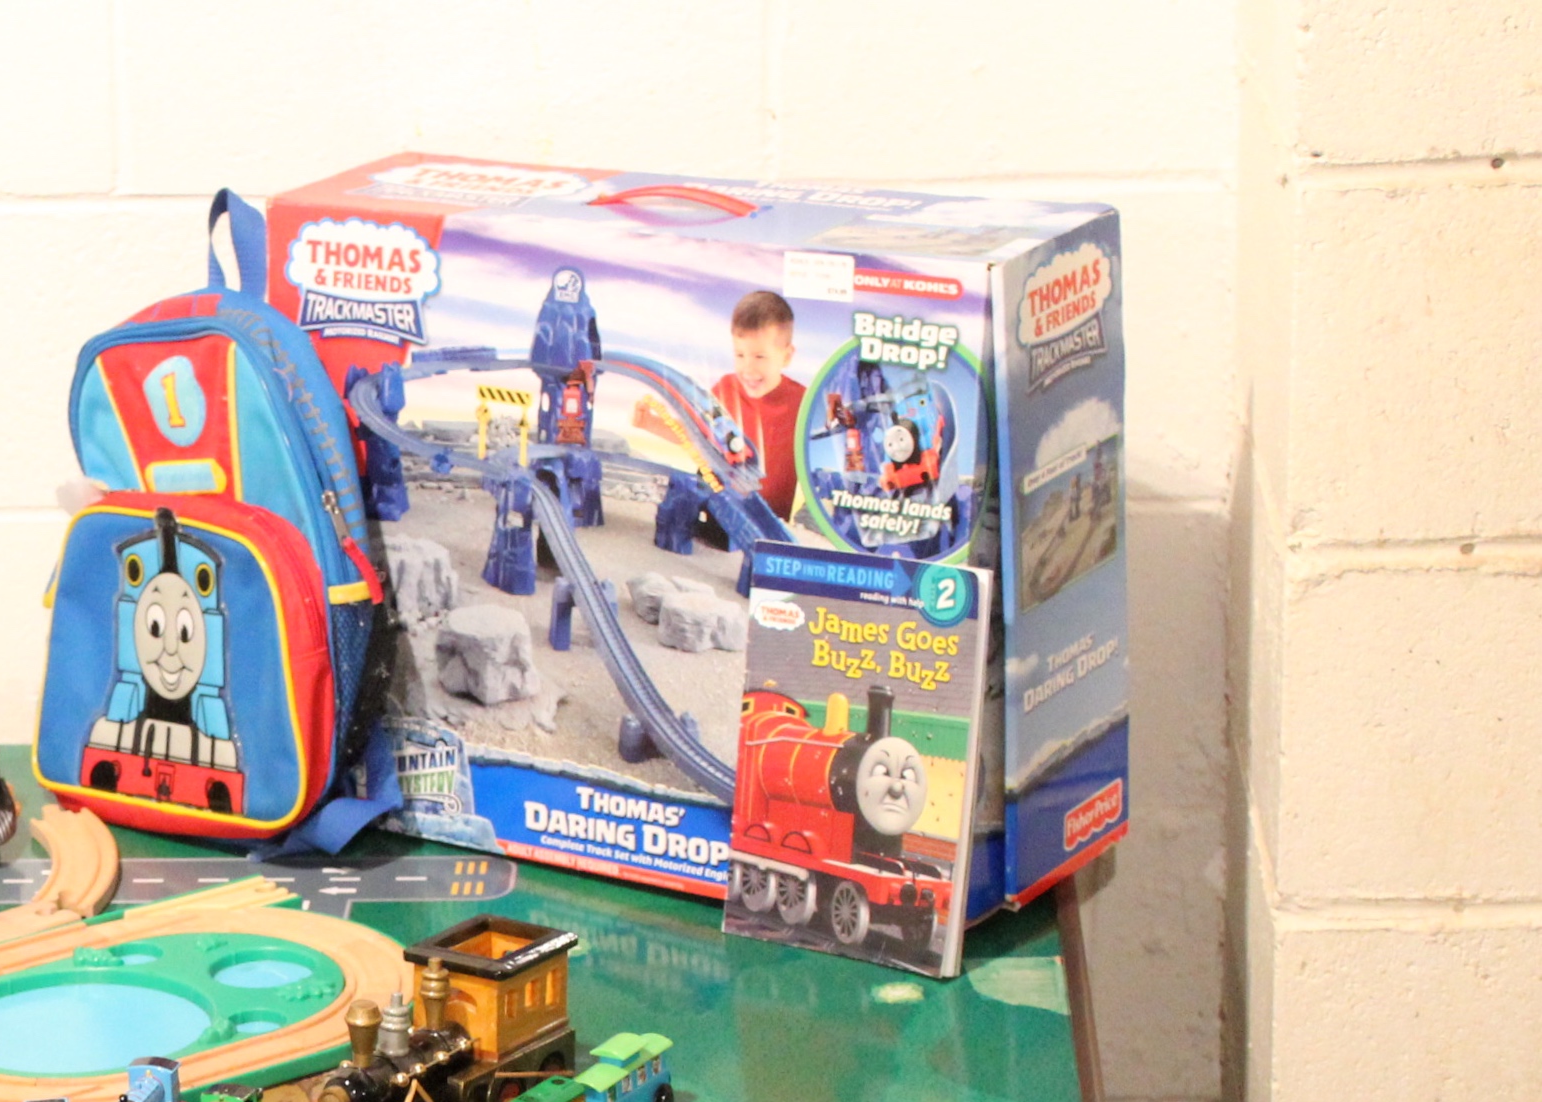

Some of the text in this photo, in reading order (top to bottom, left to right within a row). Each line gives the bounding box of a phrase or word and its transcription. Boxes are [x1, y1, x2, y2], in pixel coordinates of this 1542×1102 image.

[306, 239, 422, 274] THOMAS
[314, 268, 412, 295] & FRIENDS
[855, 275, 890, 288] ONLY
[1028, 258, 1101, 317] THOMAS
[306, 292, 418, 335] TRACKMASTER
[1034, 291, 1097, 338] & FRIENDS
[161, 372, 186, 428] 1
[831, 490, 952, 520] Thomas lands
[859, 513, 921, 536] safely!
[766, 556, 895, 590] STEP INTO READING
[936, 578, 956, 609] 2
[761, 606, 800, 618] THOMAS
[859, 592, 924, 609] reading with help
[808, 606, 960, 656] James Goes
[811, 639, 951, 691] Buzz, Buzz
[1024, 666, 1075, 714] DARING
[576, 786, 686, 827] THOMAS'
[524, 801, 730, 866] DARING DROP
[540, 835, 585, 852] Complete
[586, 844, 614, 858] Track
[614, 850, 630, 862] Set
[630, 853, 653, 866] with
[653, 857, 704, 877] Motorized
